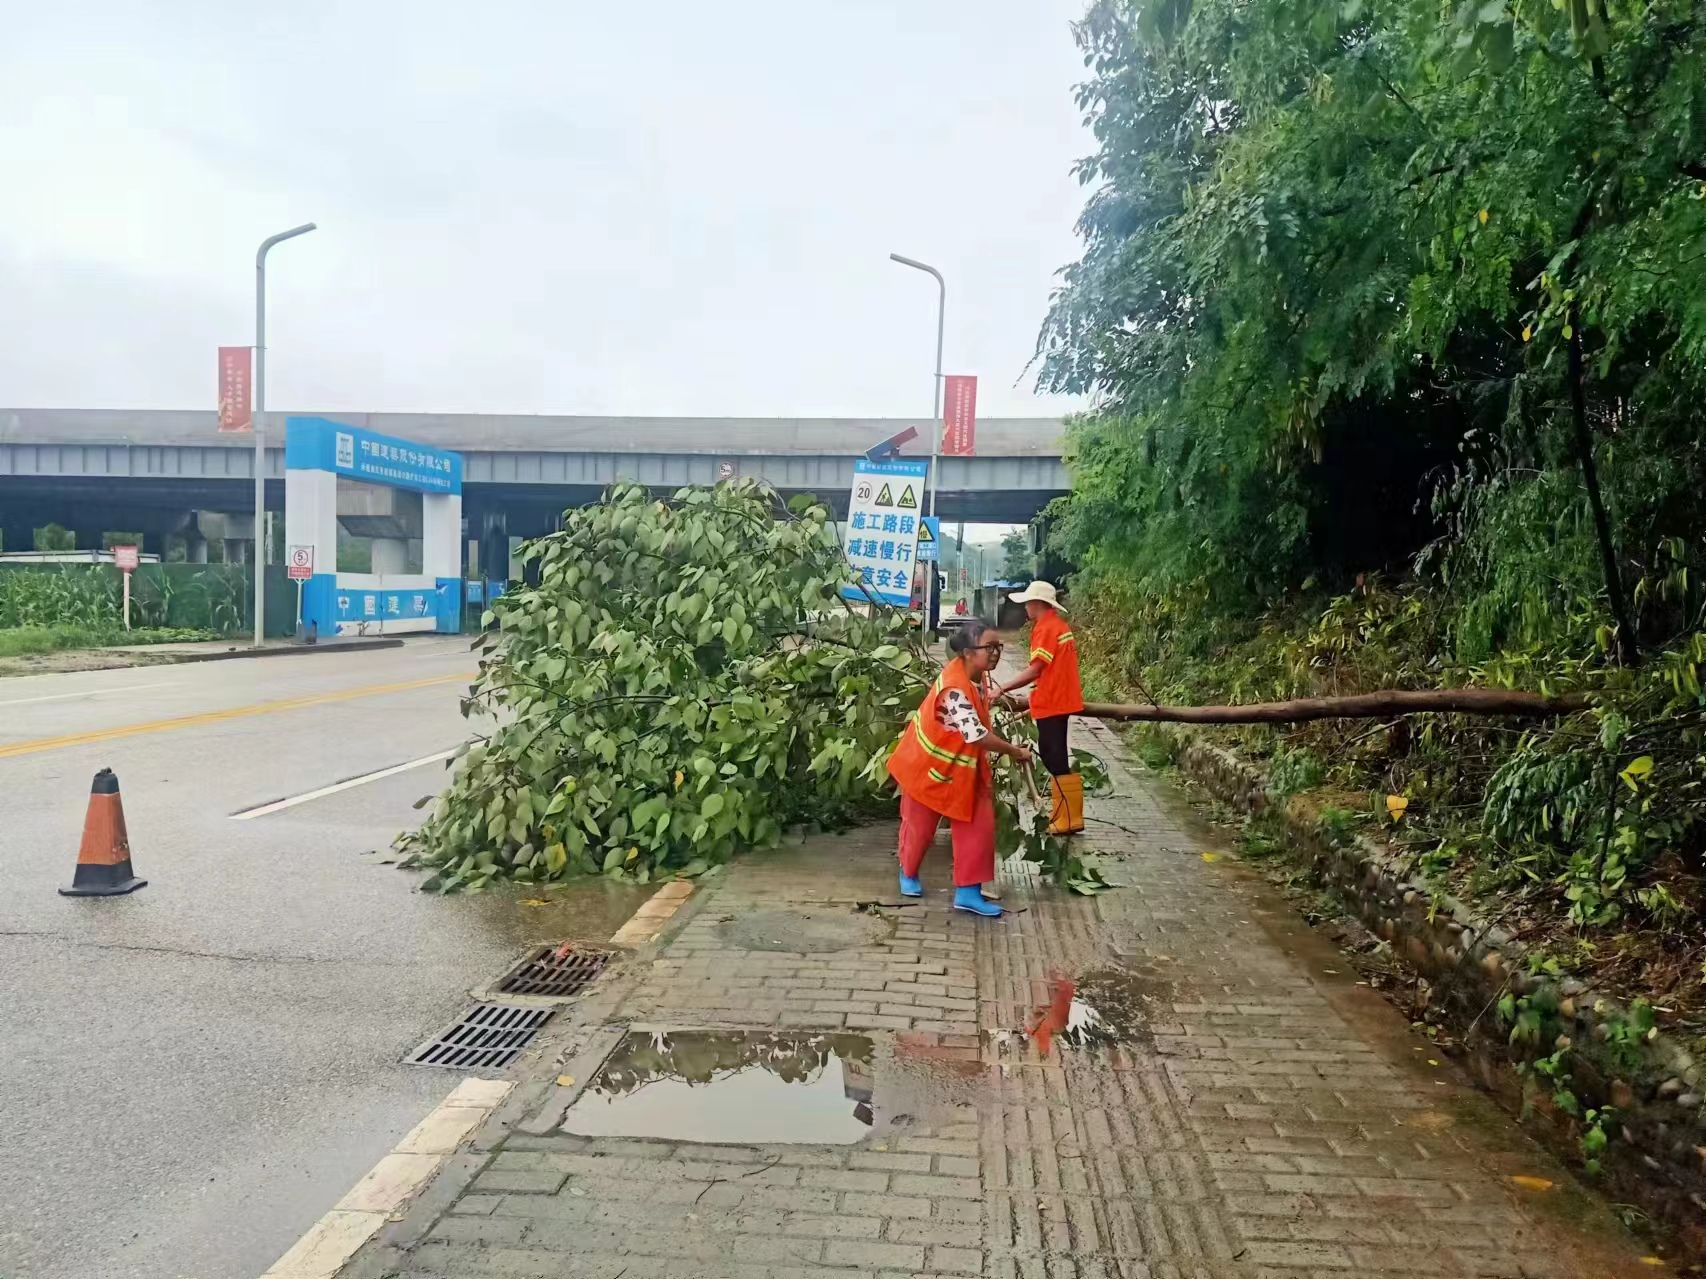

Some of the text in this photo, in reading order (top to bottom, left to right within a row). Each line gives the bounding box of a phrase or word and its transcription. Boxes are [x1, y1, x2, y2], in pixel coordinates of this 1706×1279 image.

[857, 487, 870, 499] 20
[852, 511, 915, 534] 施工路段
[848, 538, 912, 562] 减速慢行
[850, 564, 908, 589] 意安全
